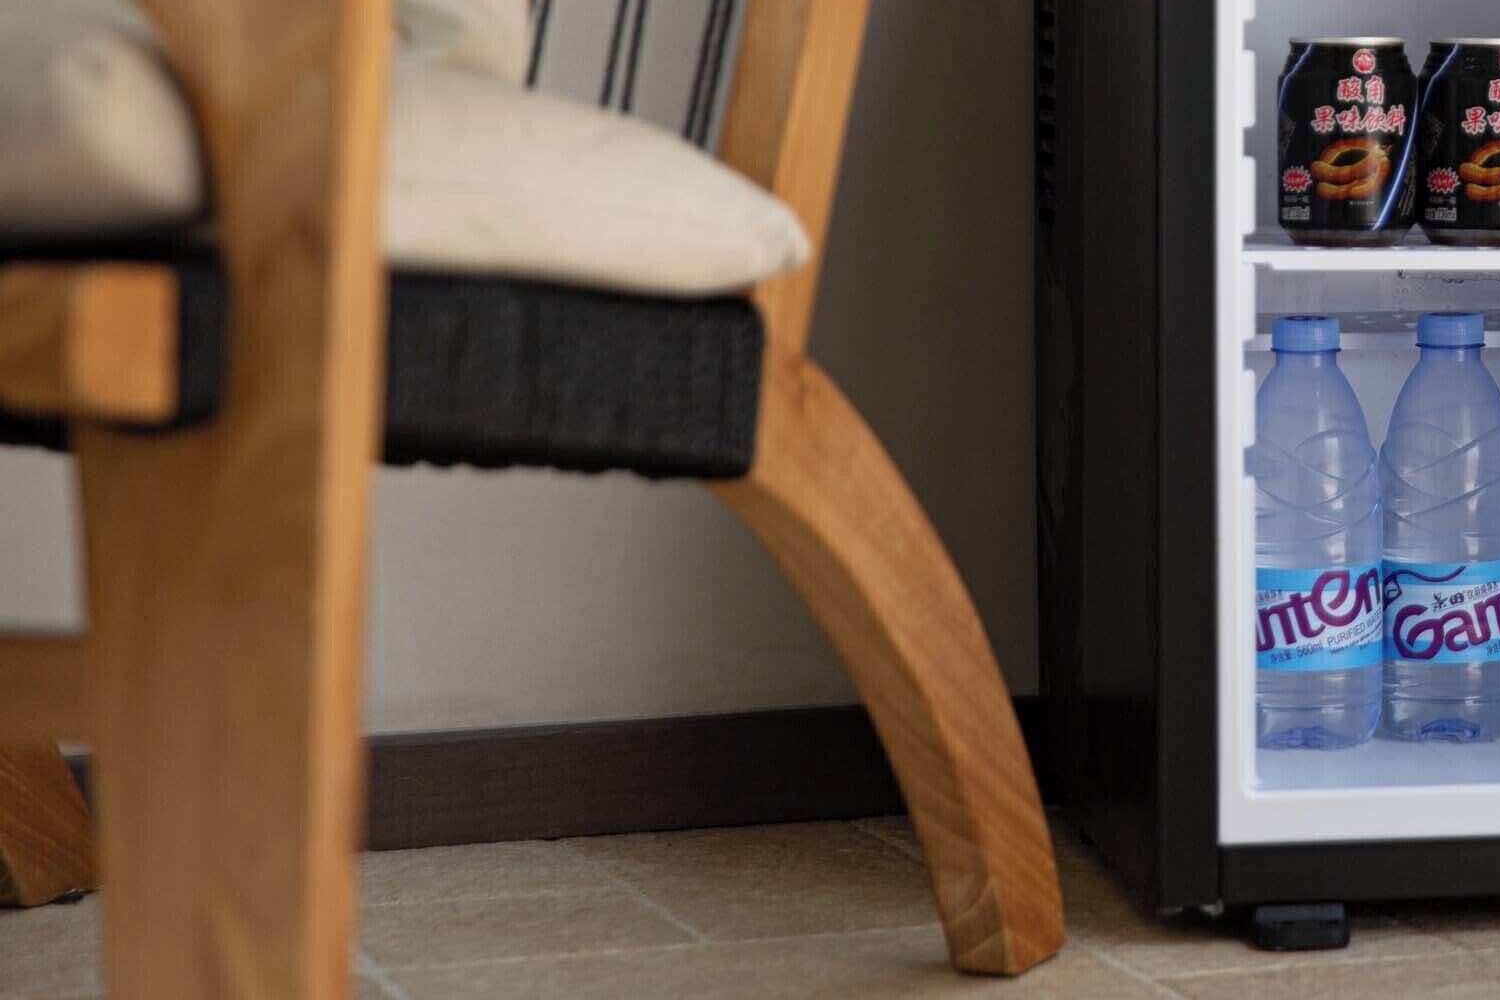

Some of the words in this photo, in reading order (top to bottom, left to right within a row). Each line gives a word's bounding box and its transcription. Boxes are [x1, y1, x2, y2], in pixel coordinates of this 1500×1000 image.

[1337, 75, 1386, 105] 酸角
[1311, 104, 1407, 137] 果味饮料
